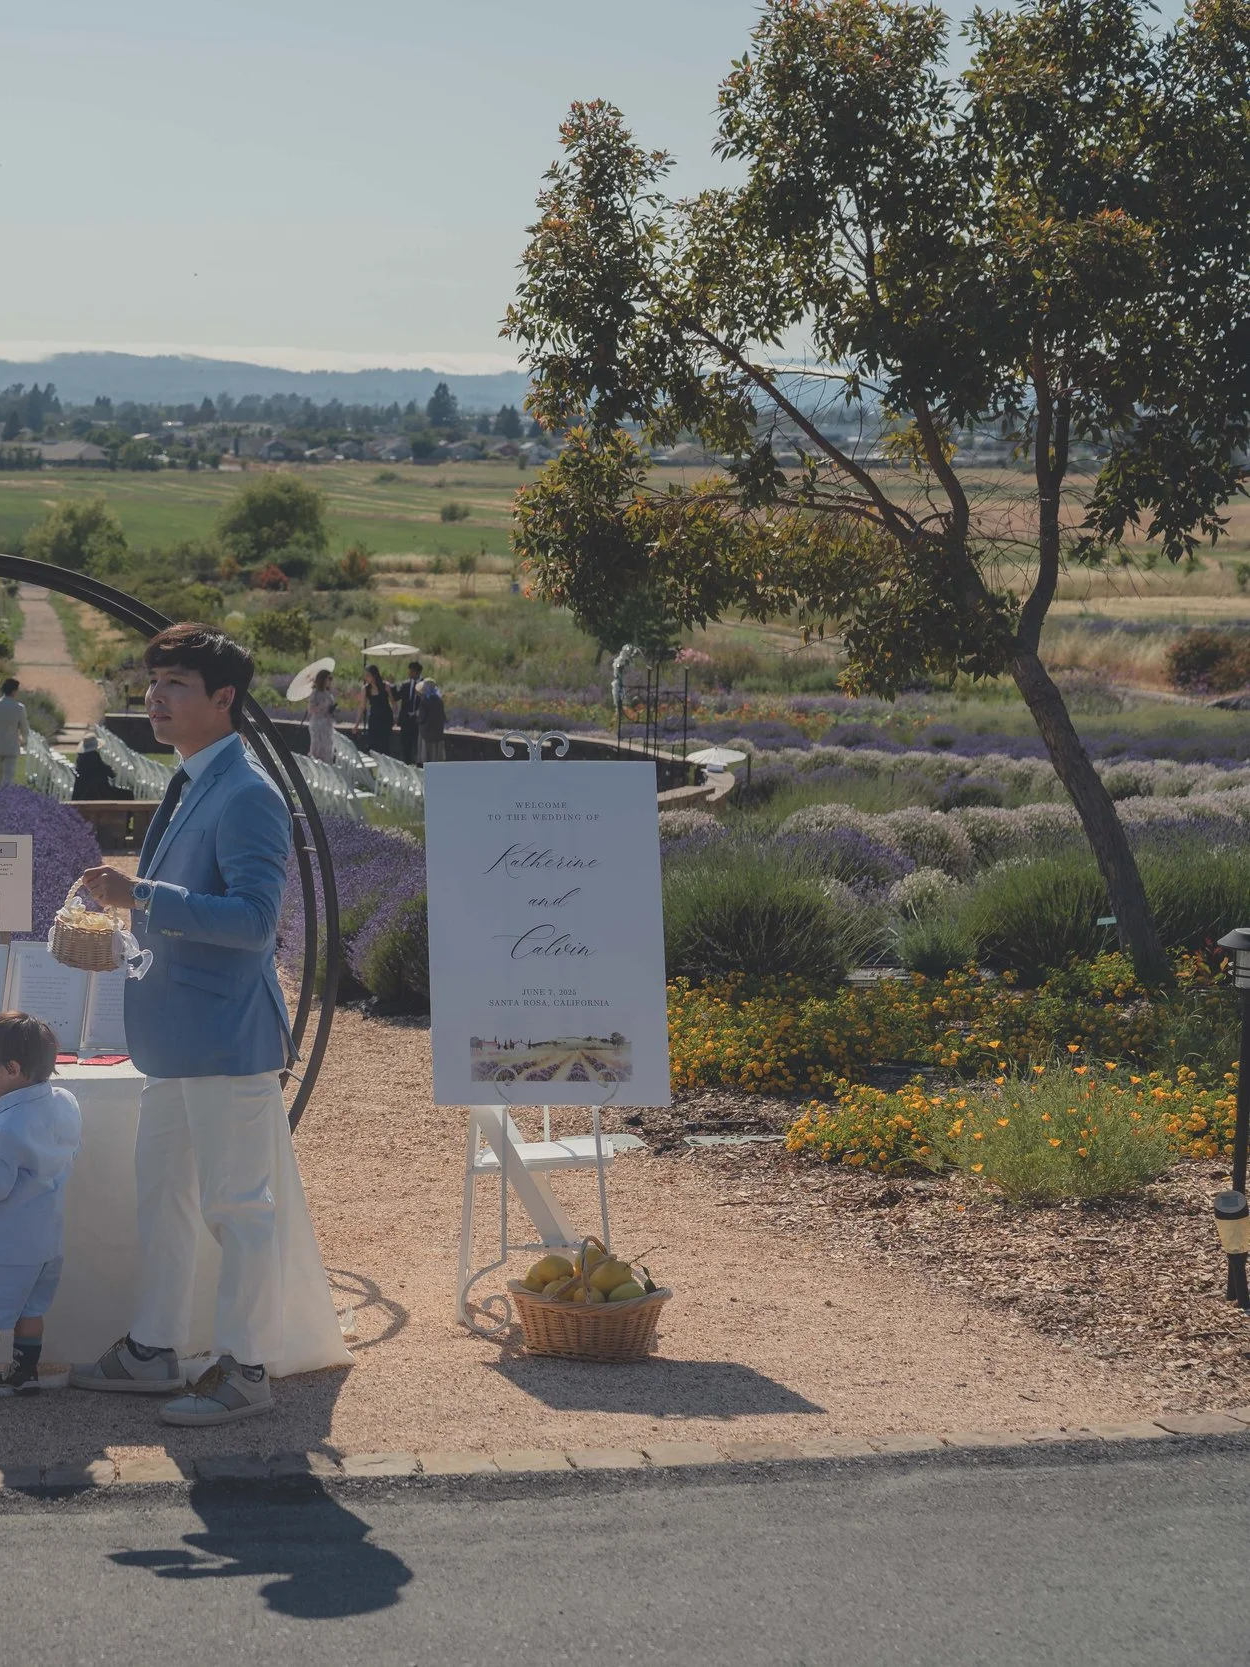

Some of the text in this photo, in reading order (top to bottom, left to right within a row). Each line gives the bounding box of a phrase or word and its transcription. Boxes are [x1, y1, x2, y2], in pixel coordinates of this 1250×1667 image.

[514, 801, 568, 809] WELCOME
[487, 813, 600, 821] TO THE WEDDING OF
[482, 841, 601, 879] Katherine
[527, 887, 582, 907] and
[490, 923, 598, 960] Calvin
[522, 988, 577, 998] JUNE 7, 2025
[489, 999, 610, 1008] SANTA ROSA, CALIFORNIA
